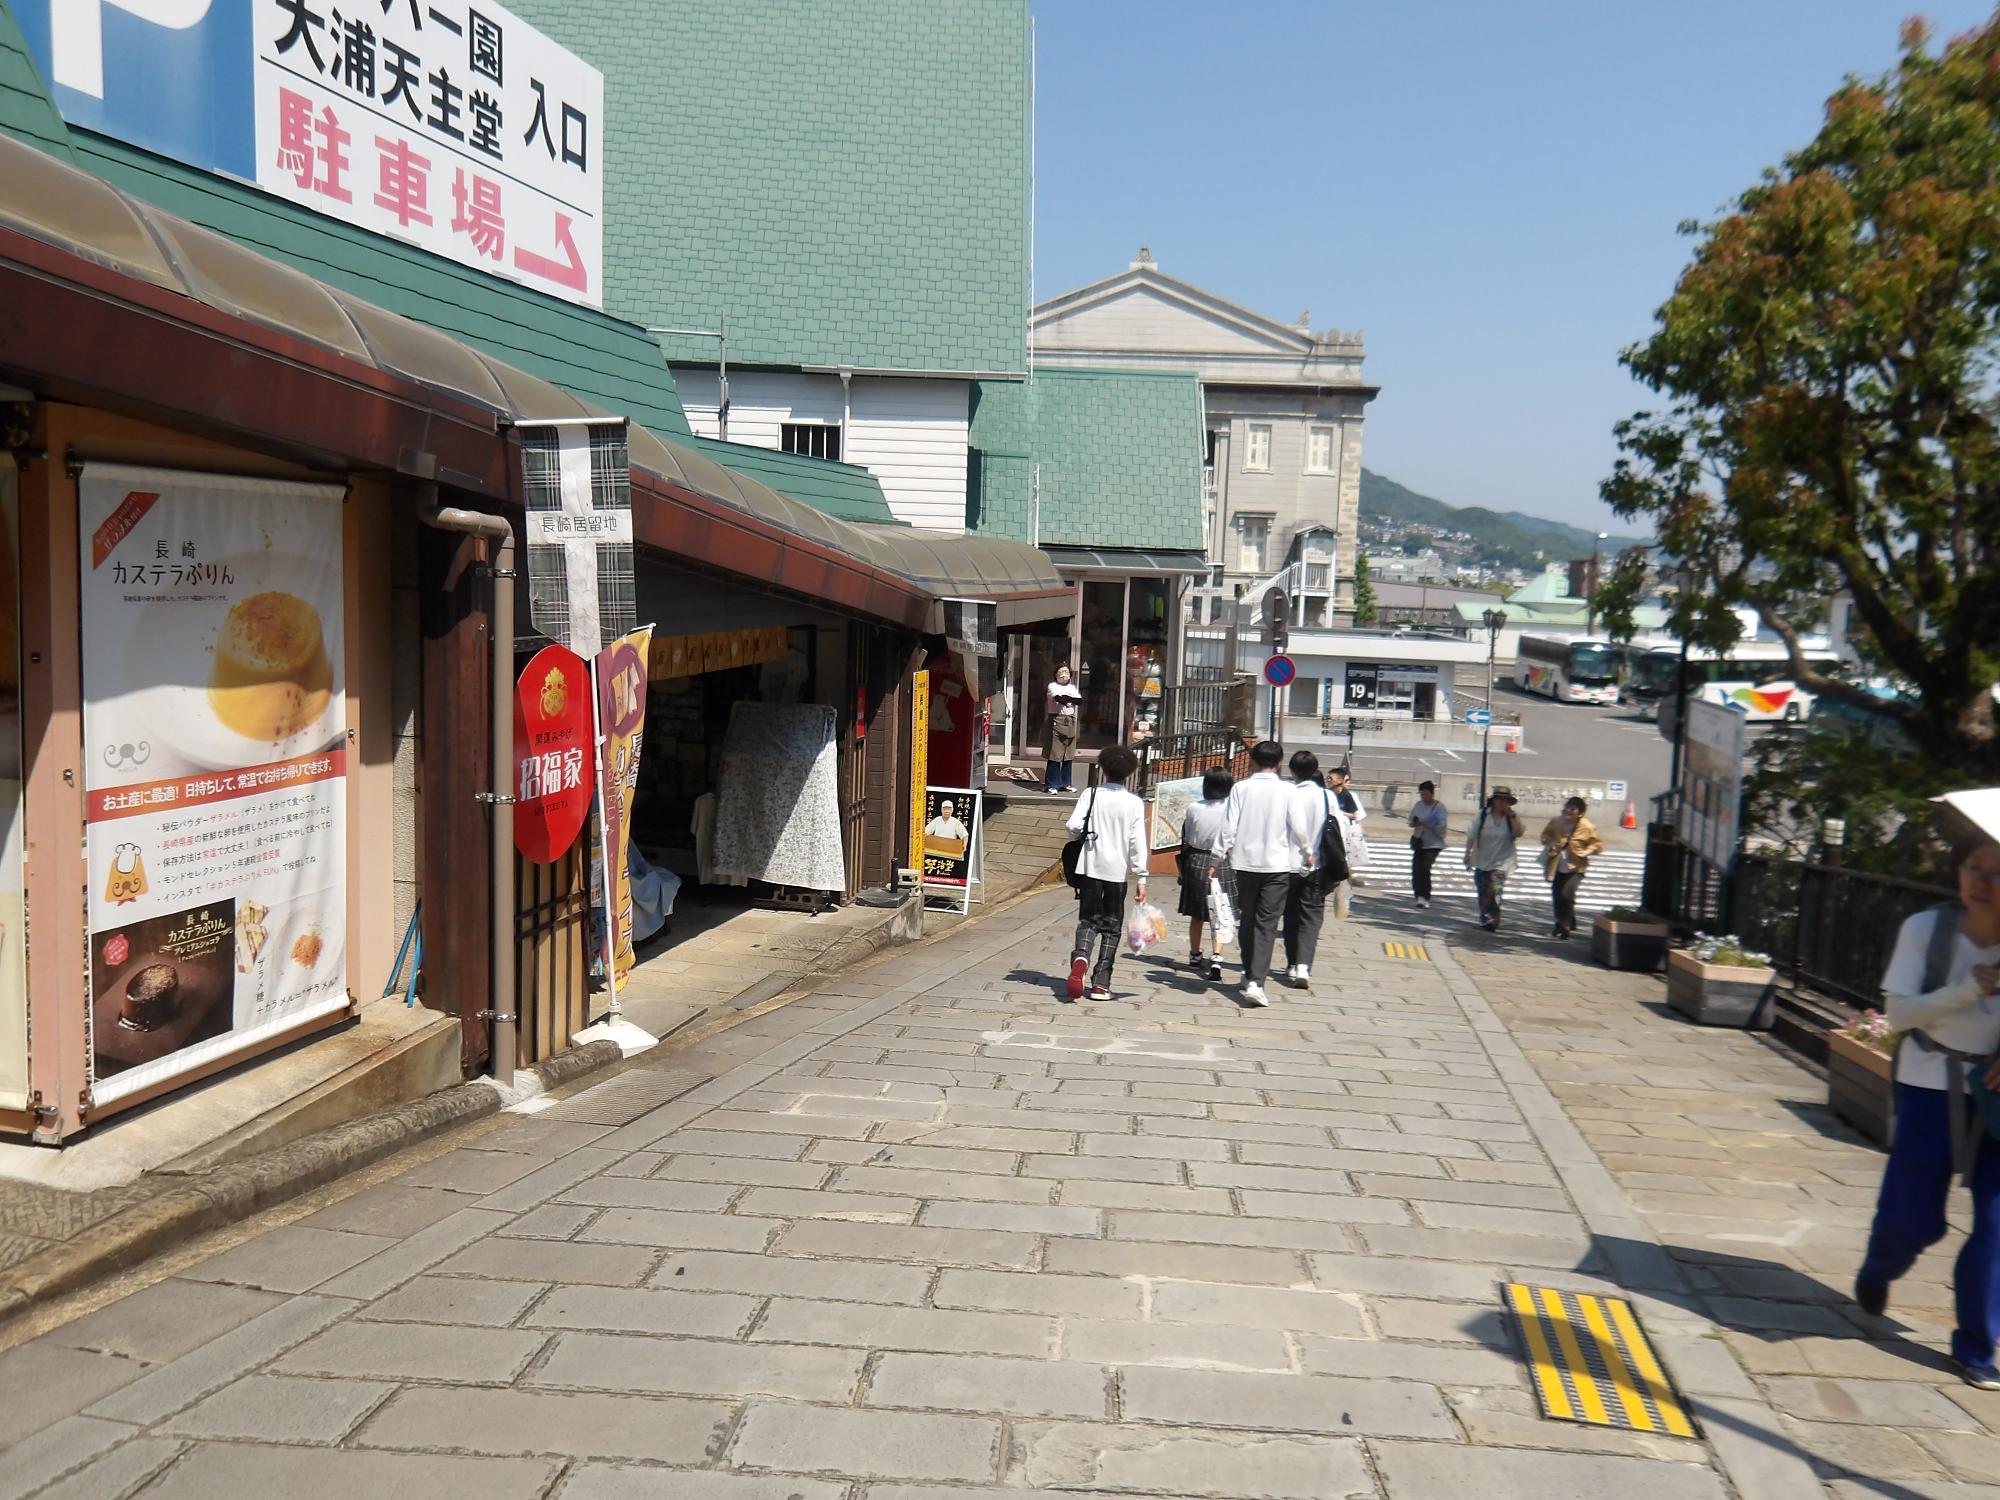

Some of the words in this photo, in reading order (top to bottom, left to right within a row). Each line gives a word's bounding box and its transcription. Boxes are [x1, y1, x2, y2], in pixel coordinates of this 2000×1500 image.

[274, 0, 504, 162] 大浦天主堂
[523, 76, 587, 174] 入口
[276, 86, 506, 262] 駐車場
[541, 515, 617, 533] 長崎居留地
[155, 539, 197, 559] 長崎
[113, 561, 235, 586] カステラぷりん
[1350, 683, 1366, 699] 19
[520, 747, 583, 802] 招福家
[168, 918, 227, 943] カステラぷりん
[186, 910, 209, 926] 長崎
